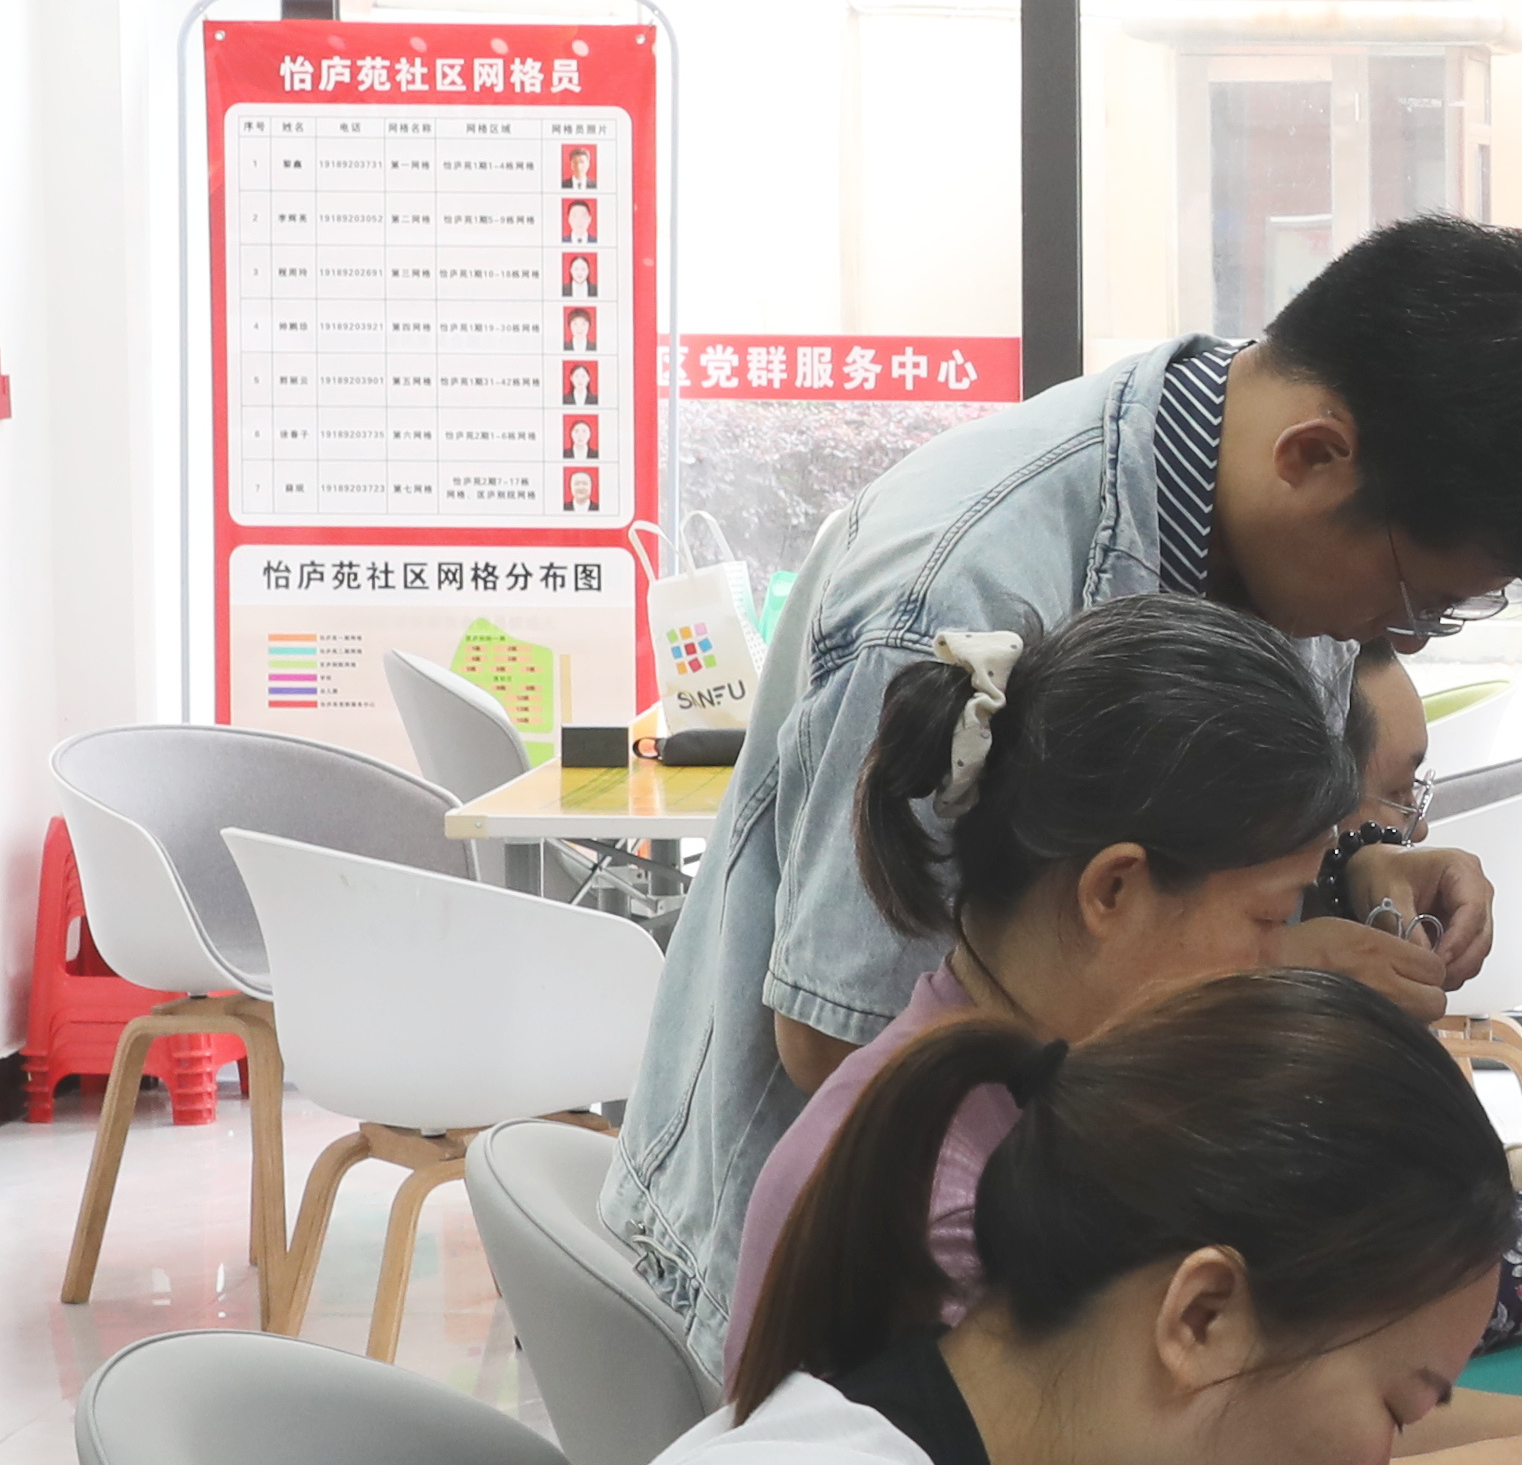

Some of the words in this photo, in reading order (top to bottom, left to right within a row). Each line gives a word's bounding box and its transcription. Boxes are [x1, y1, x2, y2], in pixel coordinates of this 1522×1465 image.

[279, 55, 582, 93] 怡庐苑社区网格员
[243, 121, 265, 132] 序号
[282, 122, 304, 133] 姓名
[339, 122, 361, 133] 电话
[388, 122, 432, 134] 网格名称
[465, 123, 512, 134] 网格区域
[551, 124, 607, 135] 网格员照片
[390, 160, 430, 171] 第一网格
[391, 214, 431, 225] 第二网格
[391, 268, 431, 279] 第三网格
[391, 322, 432, 333] 第四网格
[656, 344, 978, 391] 区党群服务中心
[392, 376, 432, 387] 第五网格
[392, 430, 432, 441] 第六网格
[393, 484, 433, 495] 第七网格
[262, 560, 603, 592] 怡庐苑社区网格分布图
